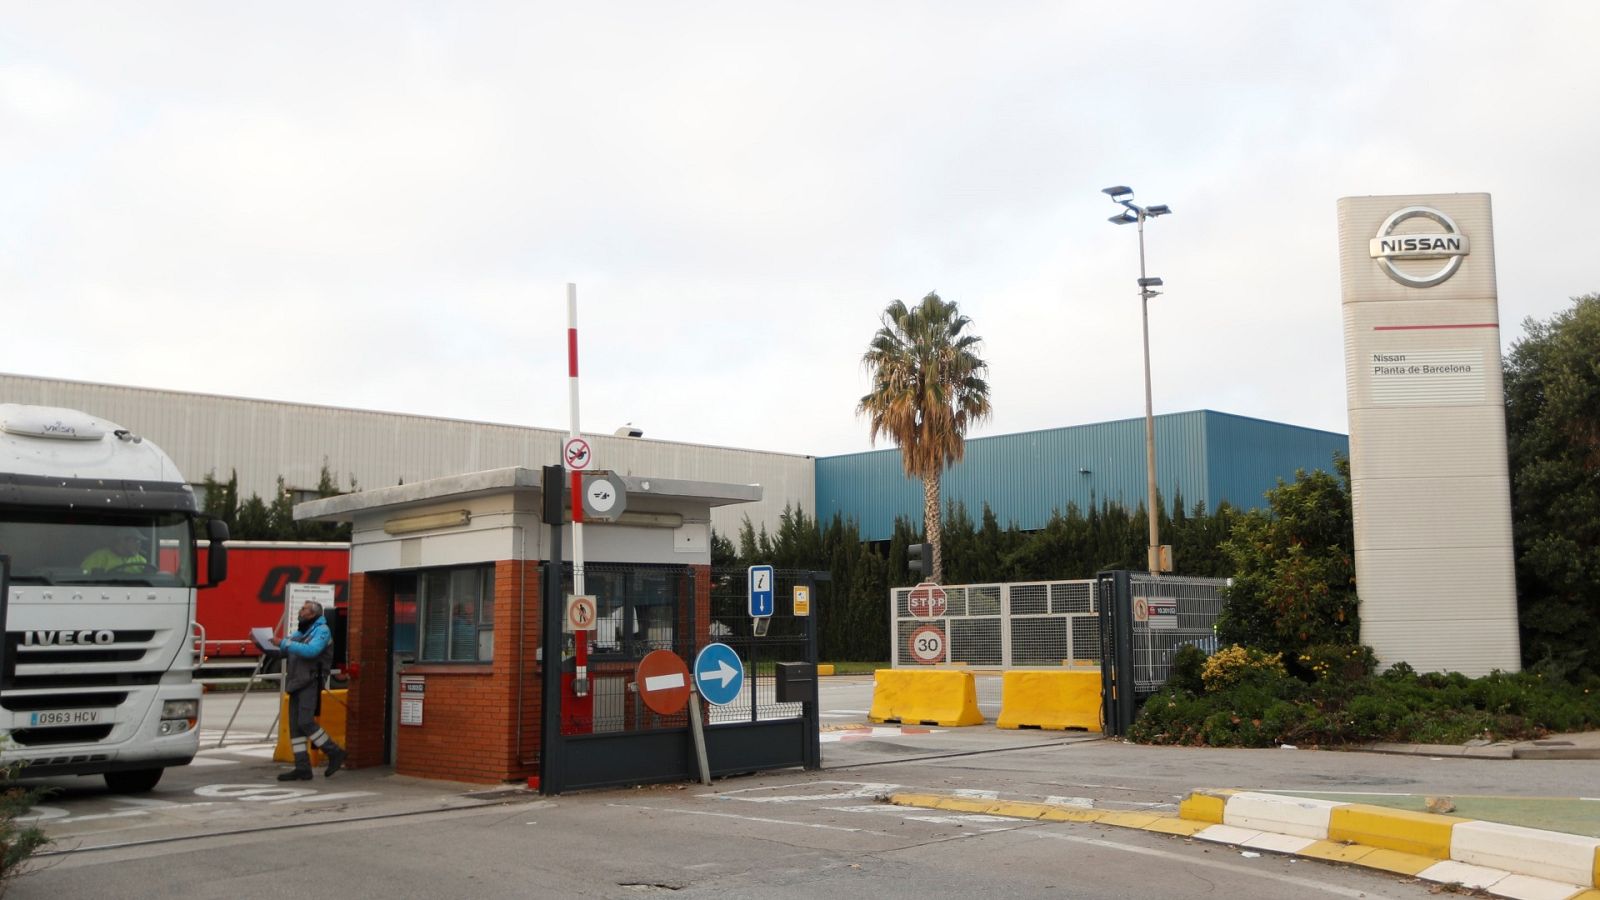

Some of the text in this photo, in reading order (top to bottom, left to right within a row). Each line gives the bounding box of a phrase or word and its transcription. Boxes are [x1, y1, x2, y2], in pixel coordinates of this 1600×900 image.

[1381, 238, 1460, 252] NISSAN
[1373, 354, 1406, 363] Nissan
[1374, 364, 1472, 376] Planta de Barcelona
[911, 598, 945, 607] STOP
[25, 630, 115, 646] IVECO
[918, 638, 939, 652] 30
[39, 711, 97, 724] 0963 HCV
